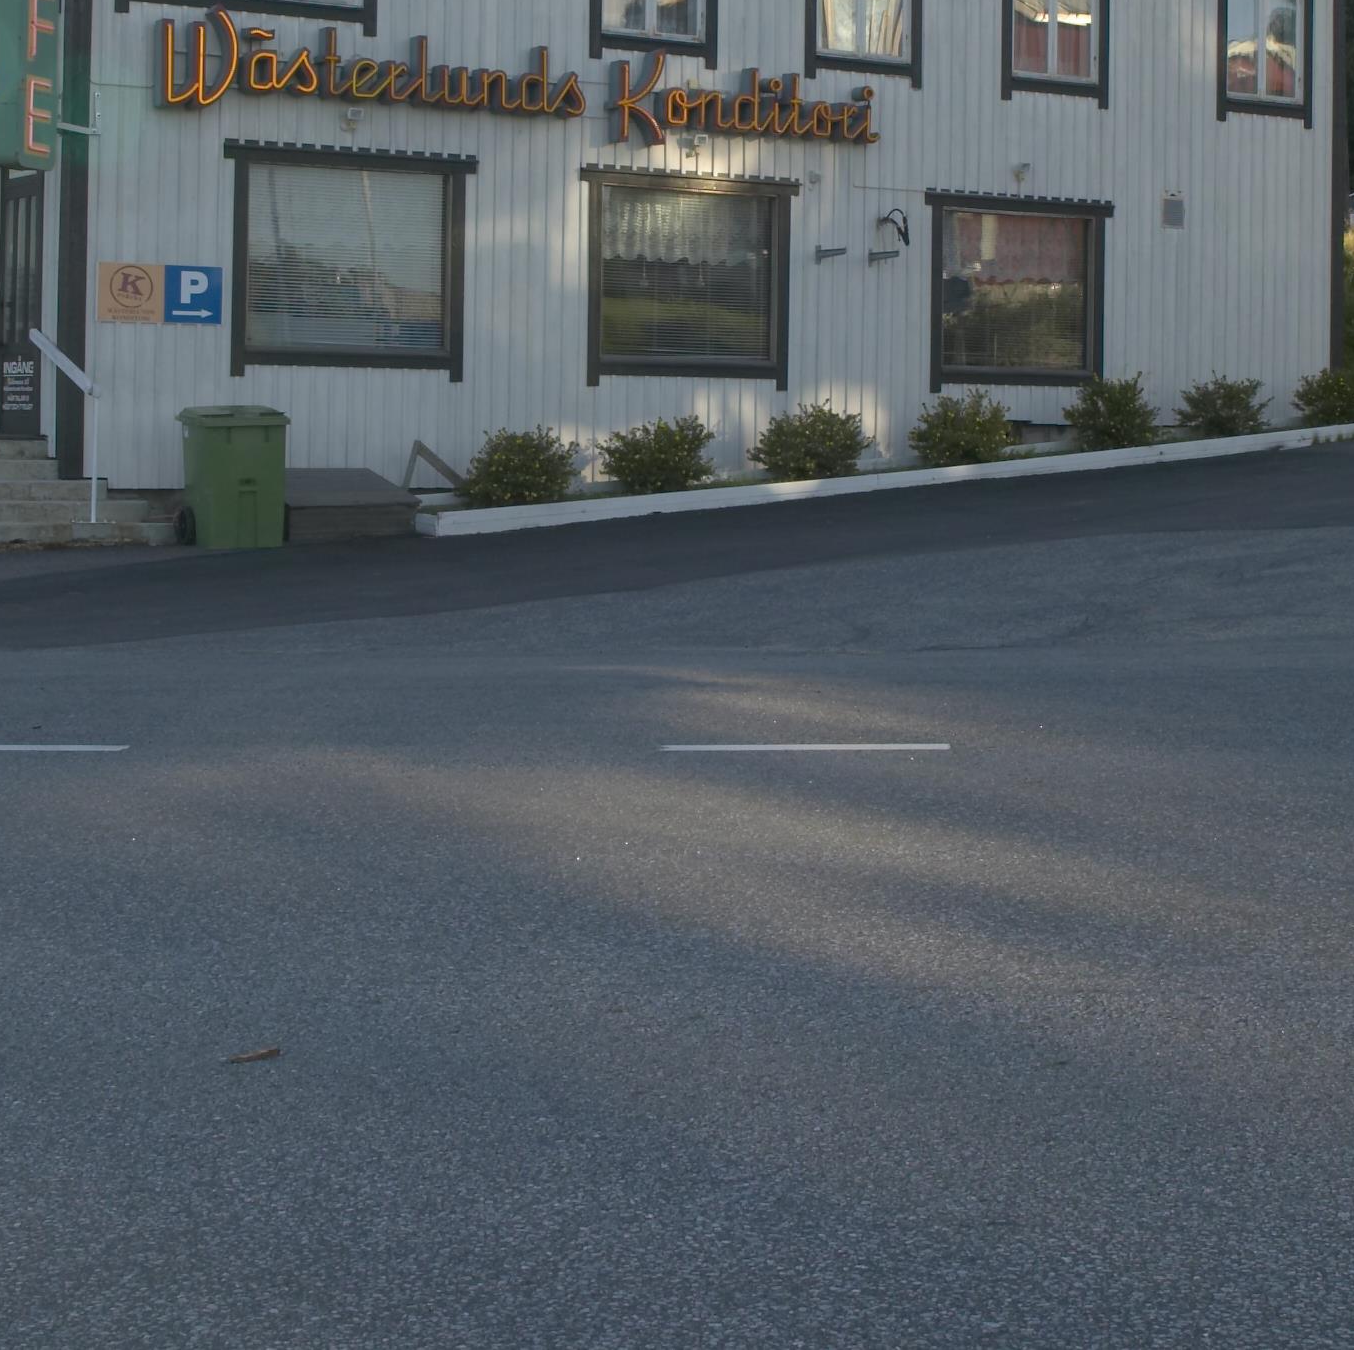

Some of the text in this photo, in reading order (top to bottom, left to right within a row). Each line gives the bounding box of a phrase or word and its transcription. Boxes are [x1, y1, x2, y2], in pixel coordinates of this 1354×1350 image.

[156, 3, 882, 146] Wästerlunds Konditori
[118, 271, 146, 295] K
[180, 270, 209, 305] P
